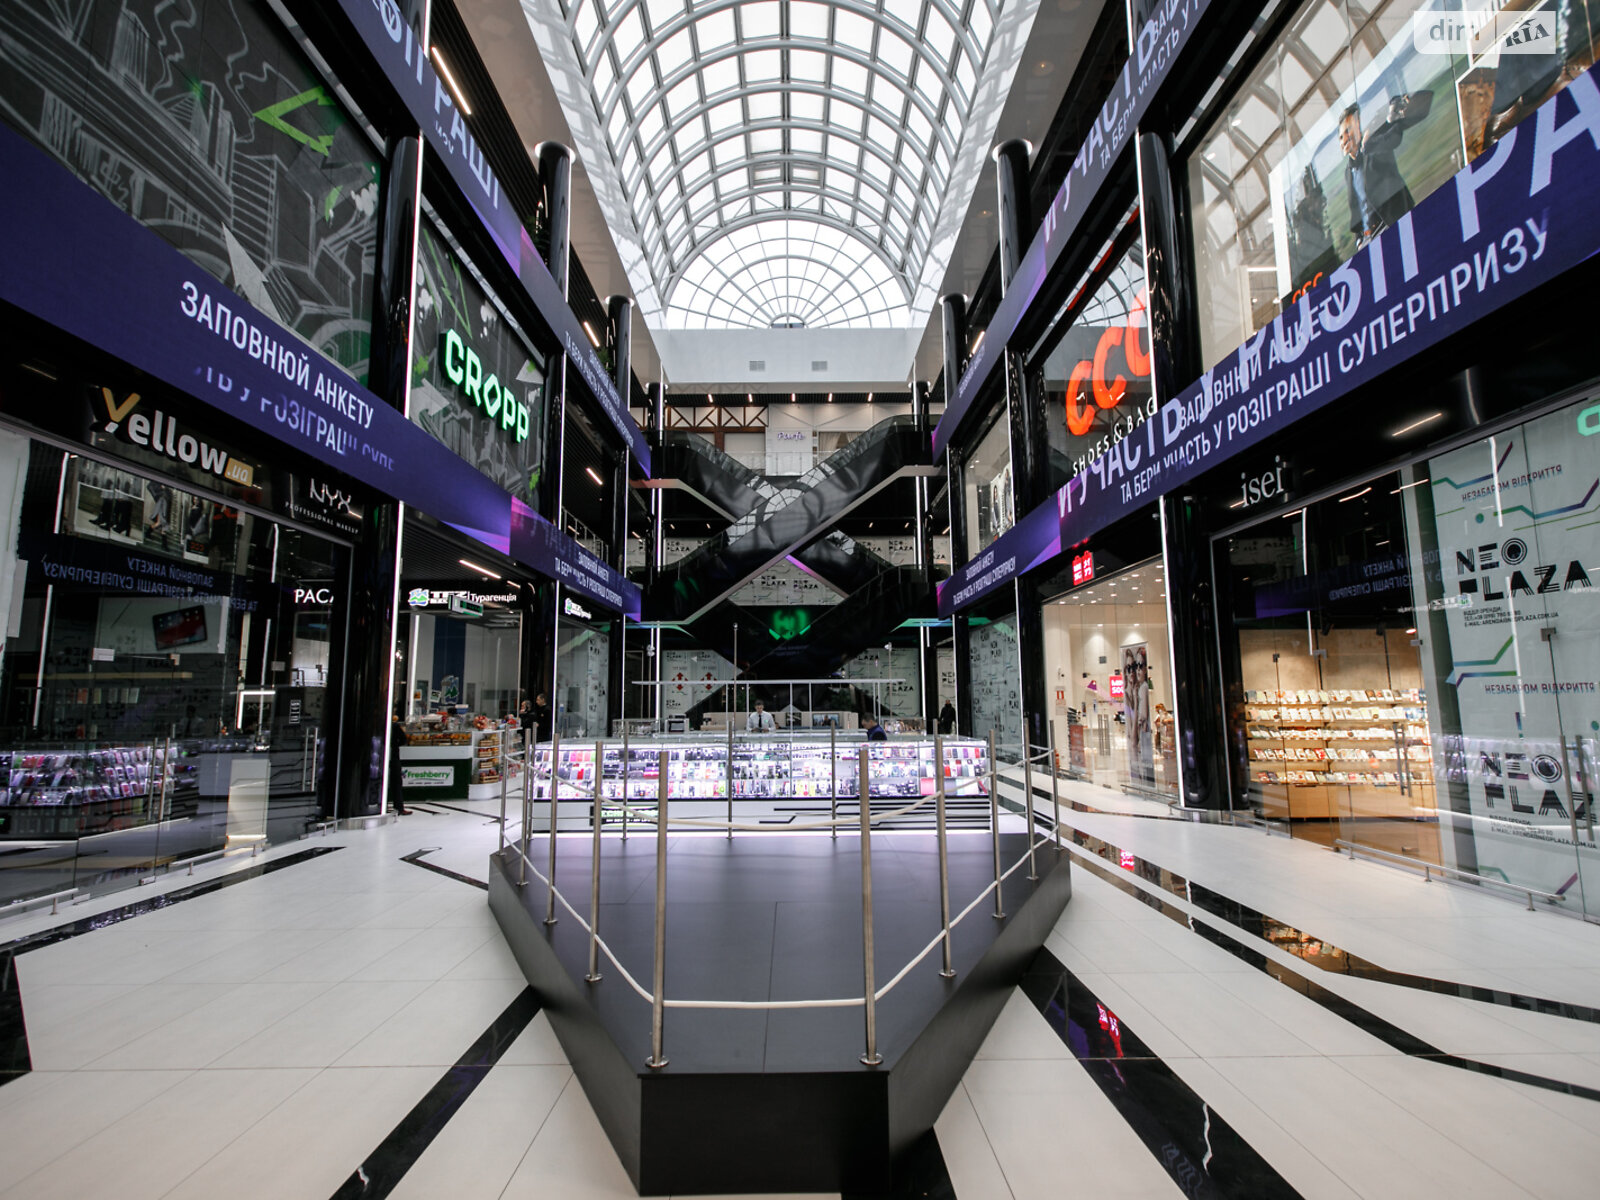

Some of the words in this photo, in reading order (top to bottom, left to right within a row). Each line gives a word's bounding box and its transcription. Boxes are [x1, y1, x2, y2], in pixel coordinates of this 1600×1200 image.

[180, 281, 310, 391] ЗАПОВНЮЙ
[314, 372, 374, 429] АНКЕТУ
[1120, 483, 1132, 504] ТА
[1213, 422, 1223, 447] У
[1228, 352, 1331, 436] РОЗІГРАШІ
[1337, 209, 1549, 373] СУПЕРПРИЗУ
[444, 328, 529, 443] CROPP
[1072, 438, 1110, 478] SHOES
[1512, 464, 1562, 488] ВІДКРИТТЯ
[309, 477, 351, 513] NYX
[1456, 537, 1528, 575] NEO
[471, 593, 517, 603] Турагенція
[1542, 682, 1595, 694] ВІДКРИТТЯ
[1480, 751, 1563, 784] NEO
